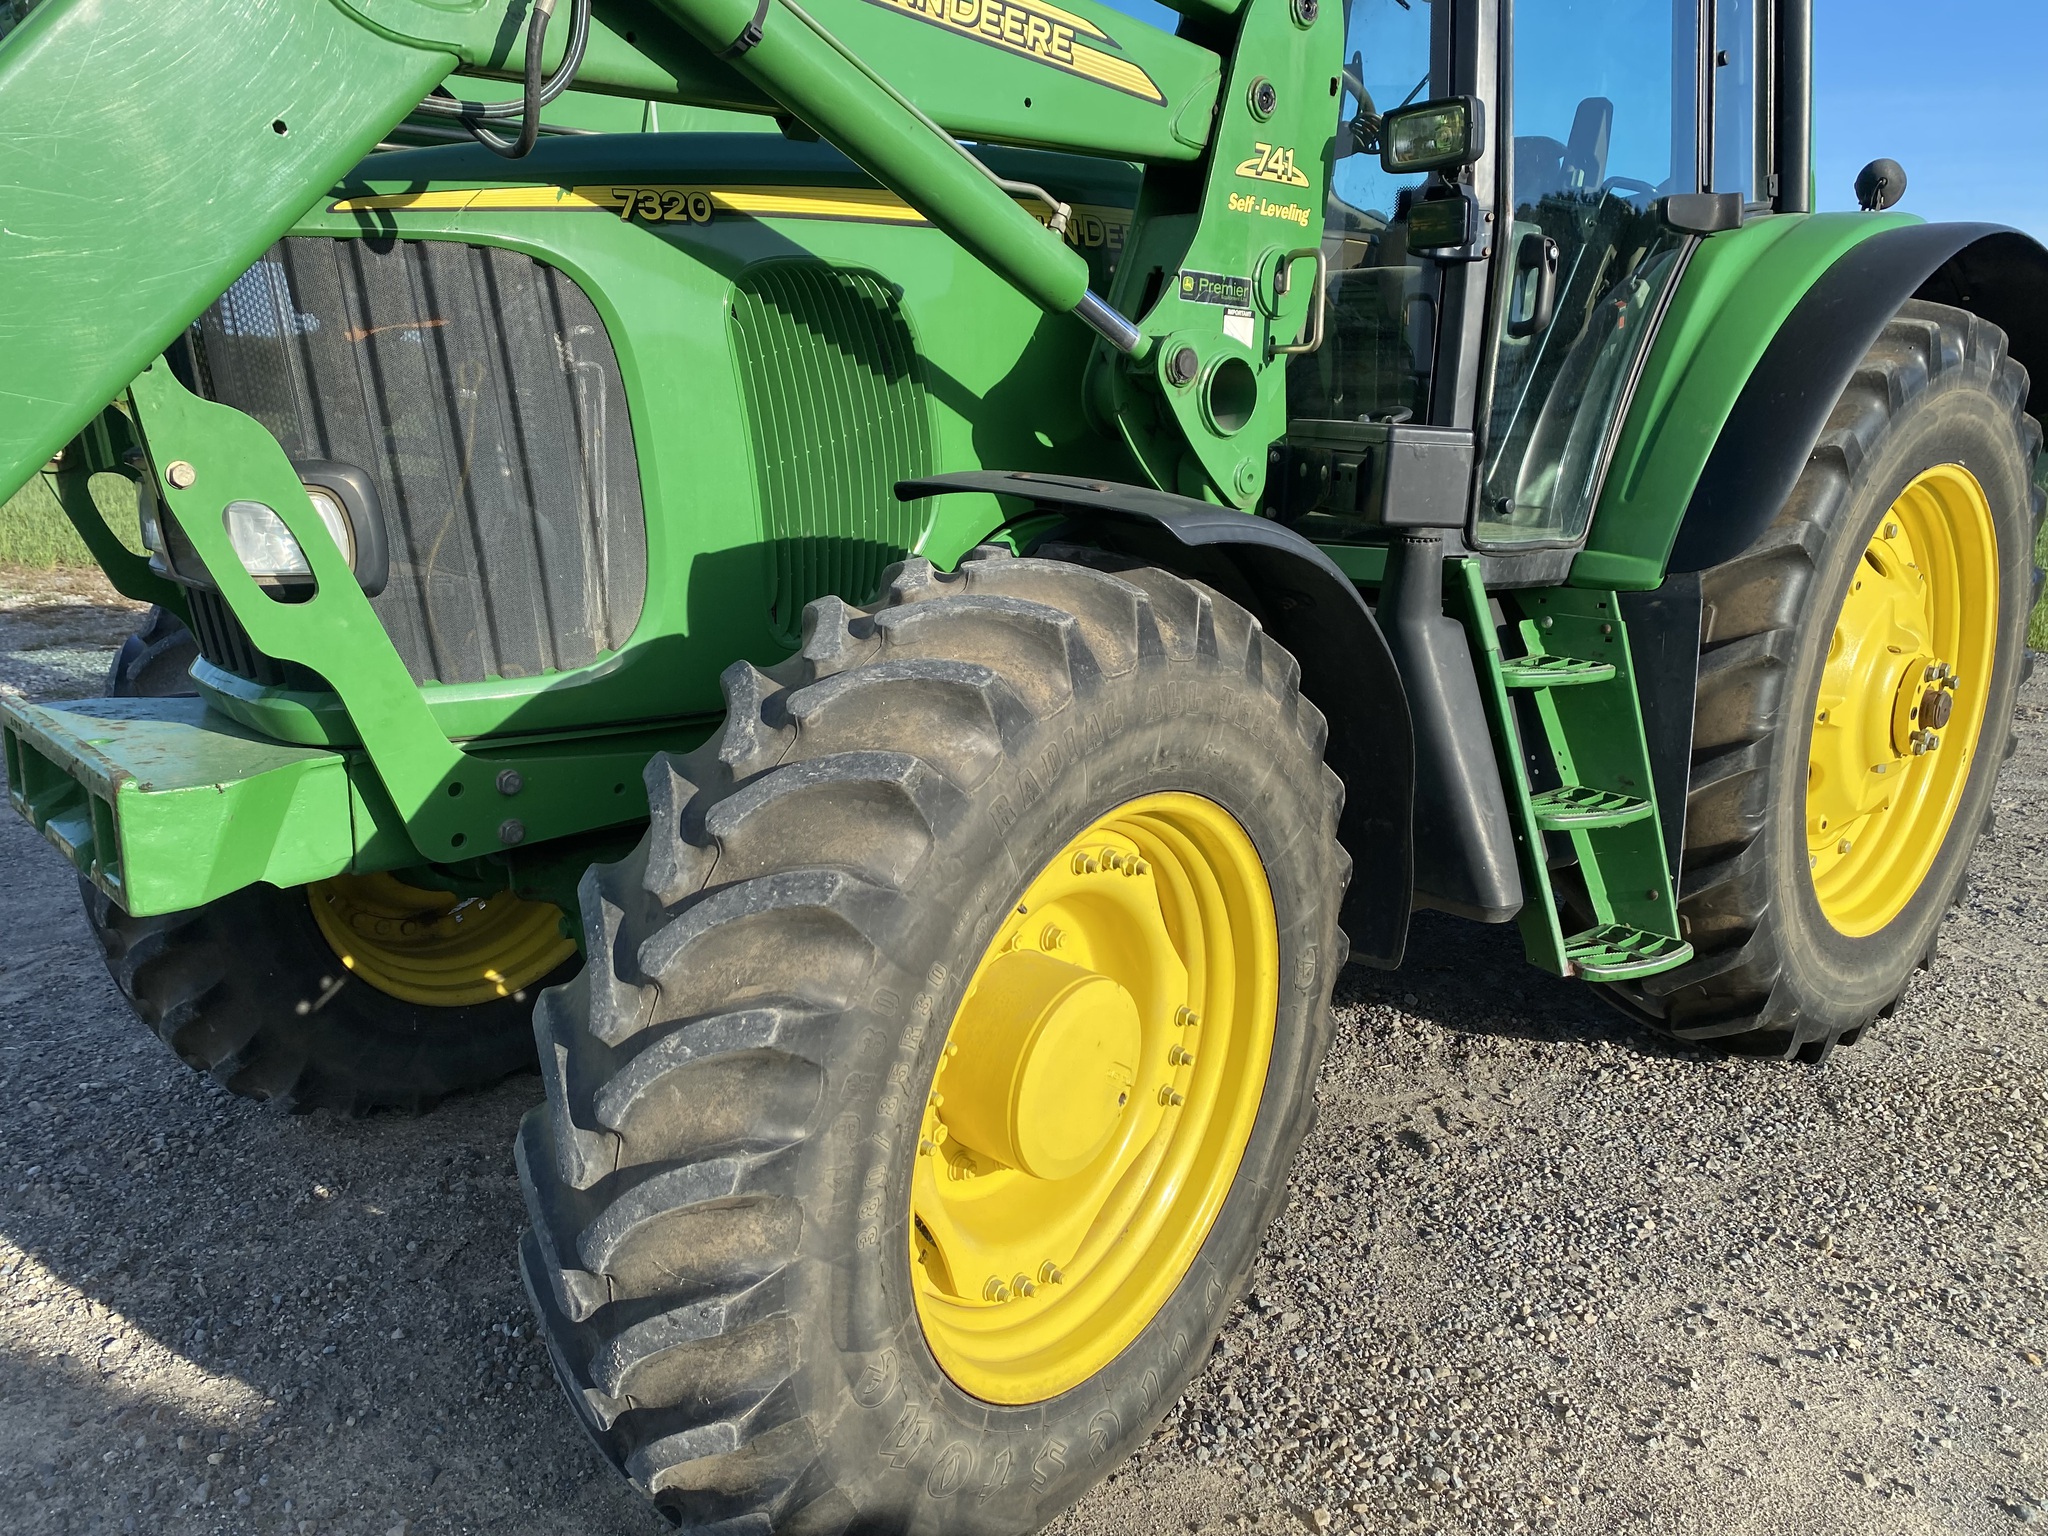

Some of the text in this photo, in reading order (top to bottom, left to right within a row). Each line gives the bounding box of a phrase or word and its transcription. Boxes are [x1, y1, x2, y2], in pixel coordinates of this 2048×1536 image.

[949, 0, 1074, 65] DEERE
[1254, 141, 1294, 181] 741
[611, 188, 714, 227] 7320
[1199, 277, 1249, 298] Premier
[1227, 308, 1252, 317] IMPORTANT
[988, 701, 1124, 837] RADIAL
[1148, 680, 1203, 723] ALL
[856, 960, 948, 1250] 380/85R30
